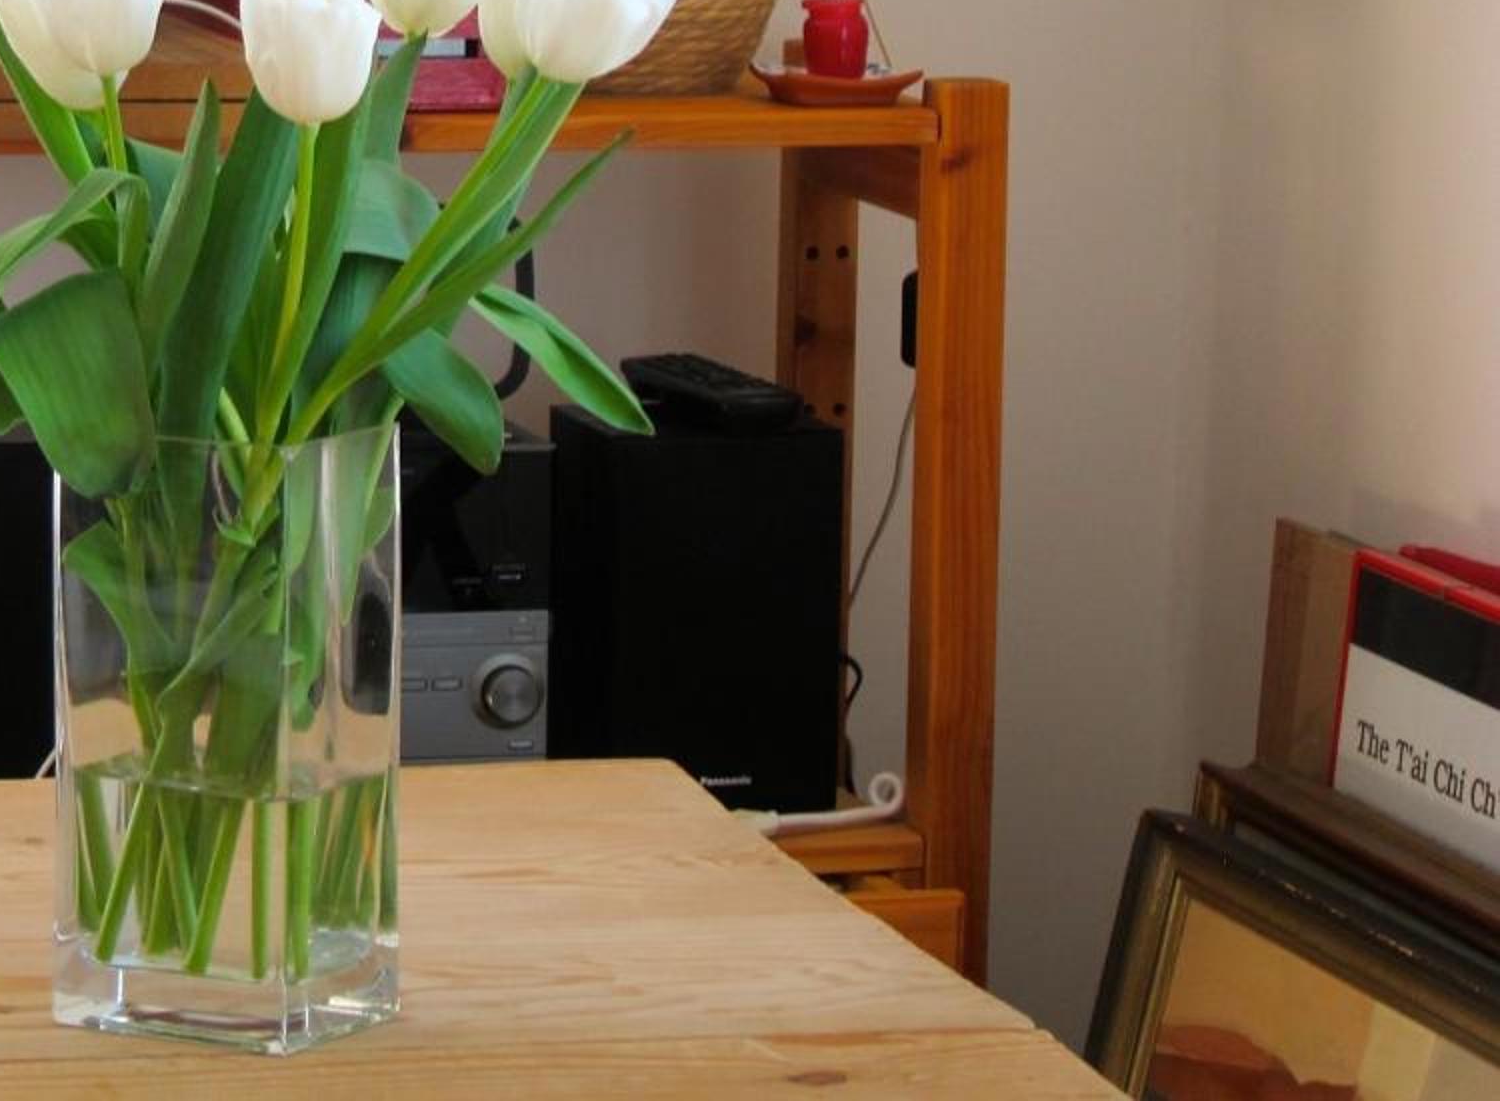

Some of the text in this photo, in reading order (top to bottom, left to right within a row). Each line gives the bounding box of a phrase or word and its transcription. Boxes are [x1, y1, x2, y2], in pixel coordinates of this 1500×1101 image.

[1357, 719, 1389, 765] The
[1395, 738, 1429, 785] T'ai
[1433, 758, 1467, 804] Chi
